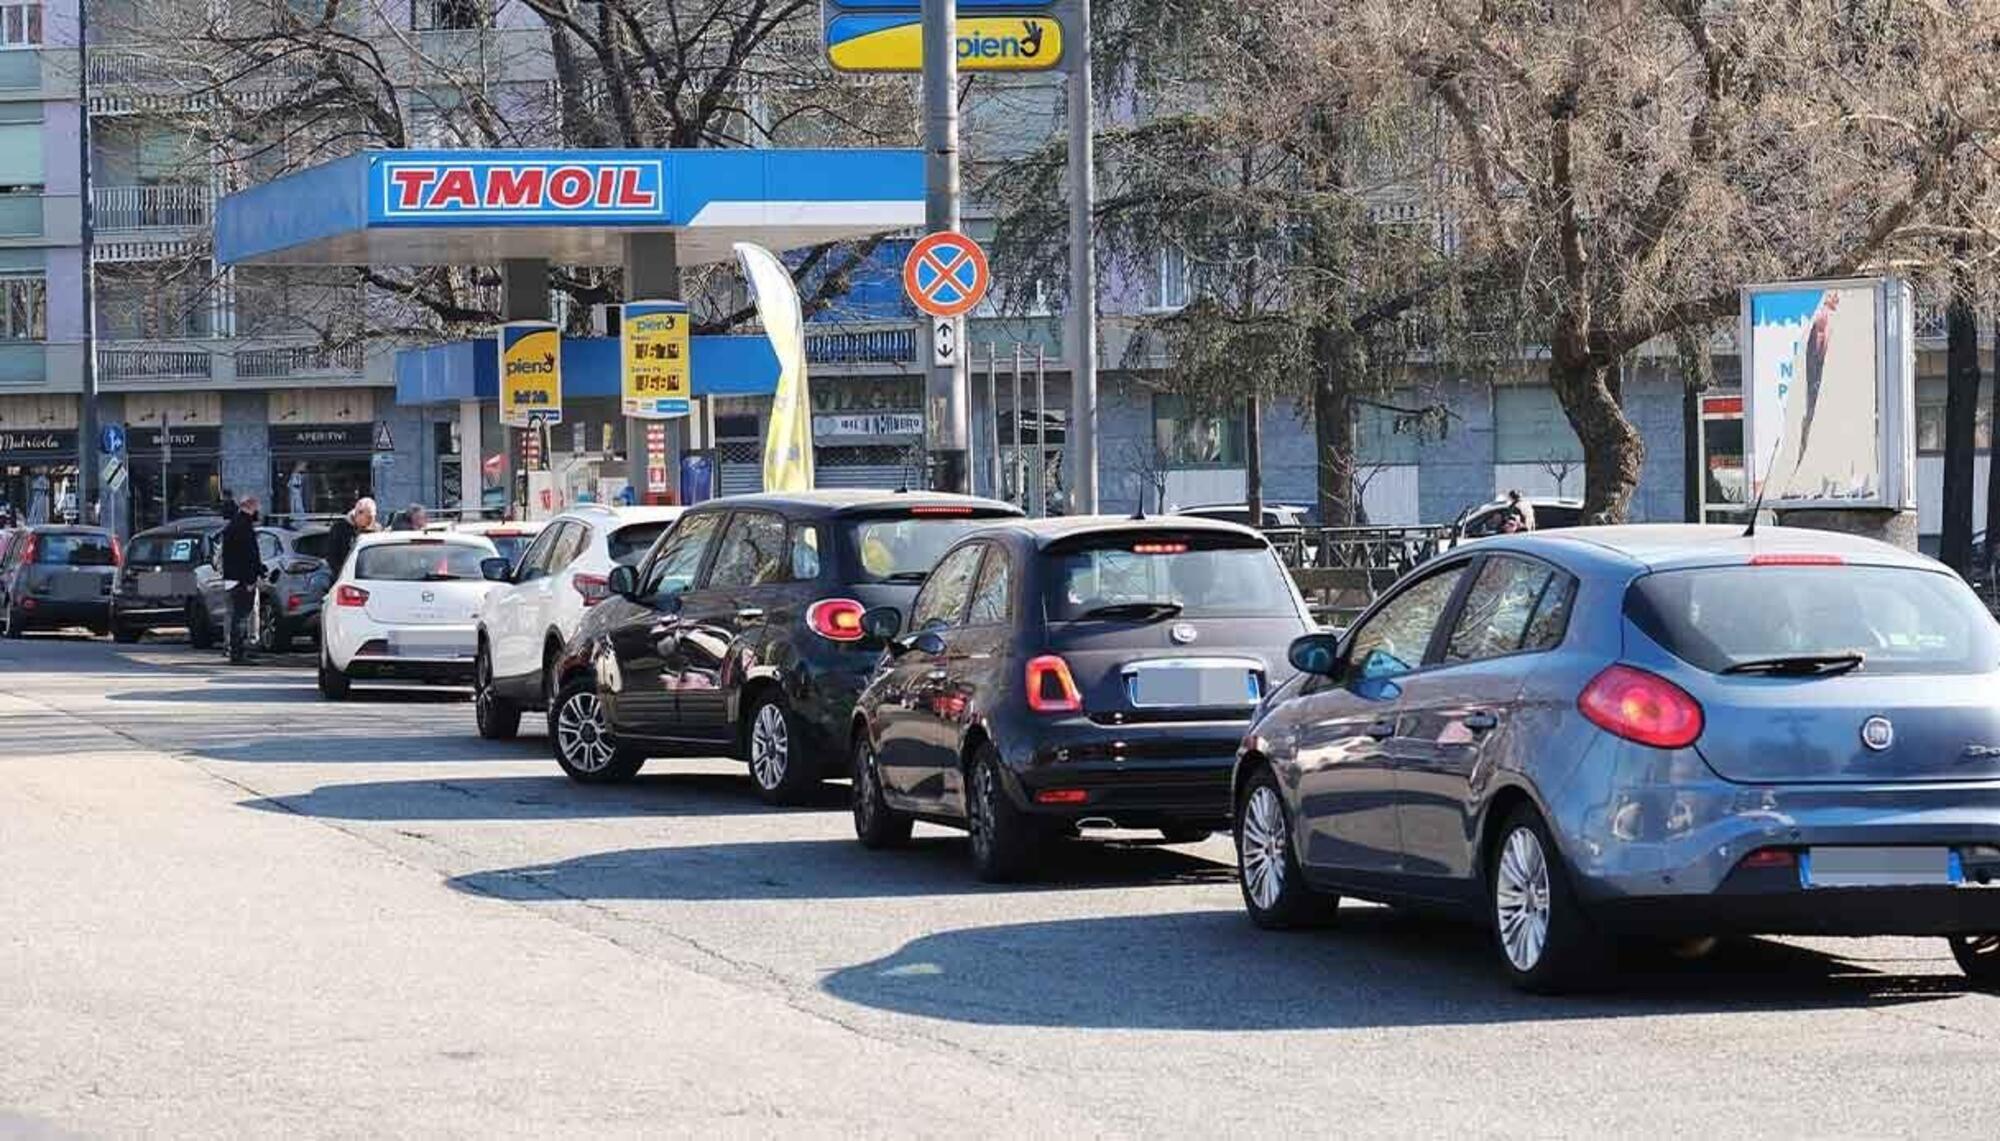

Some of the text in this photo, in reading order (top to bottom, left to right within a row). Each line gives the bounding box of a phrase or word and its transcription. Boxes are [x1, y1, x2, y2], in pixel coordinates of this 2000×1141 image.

[391, 167, 655, 209] TAMOIL
[506, 354, 555, 377] pieno
[152, 434, 195, 445] BITROT
